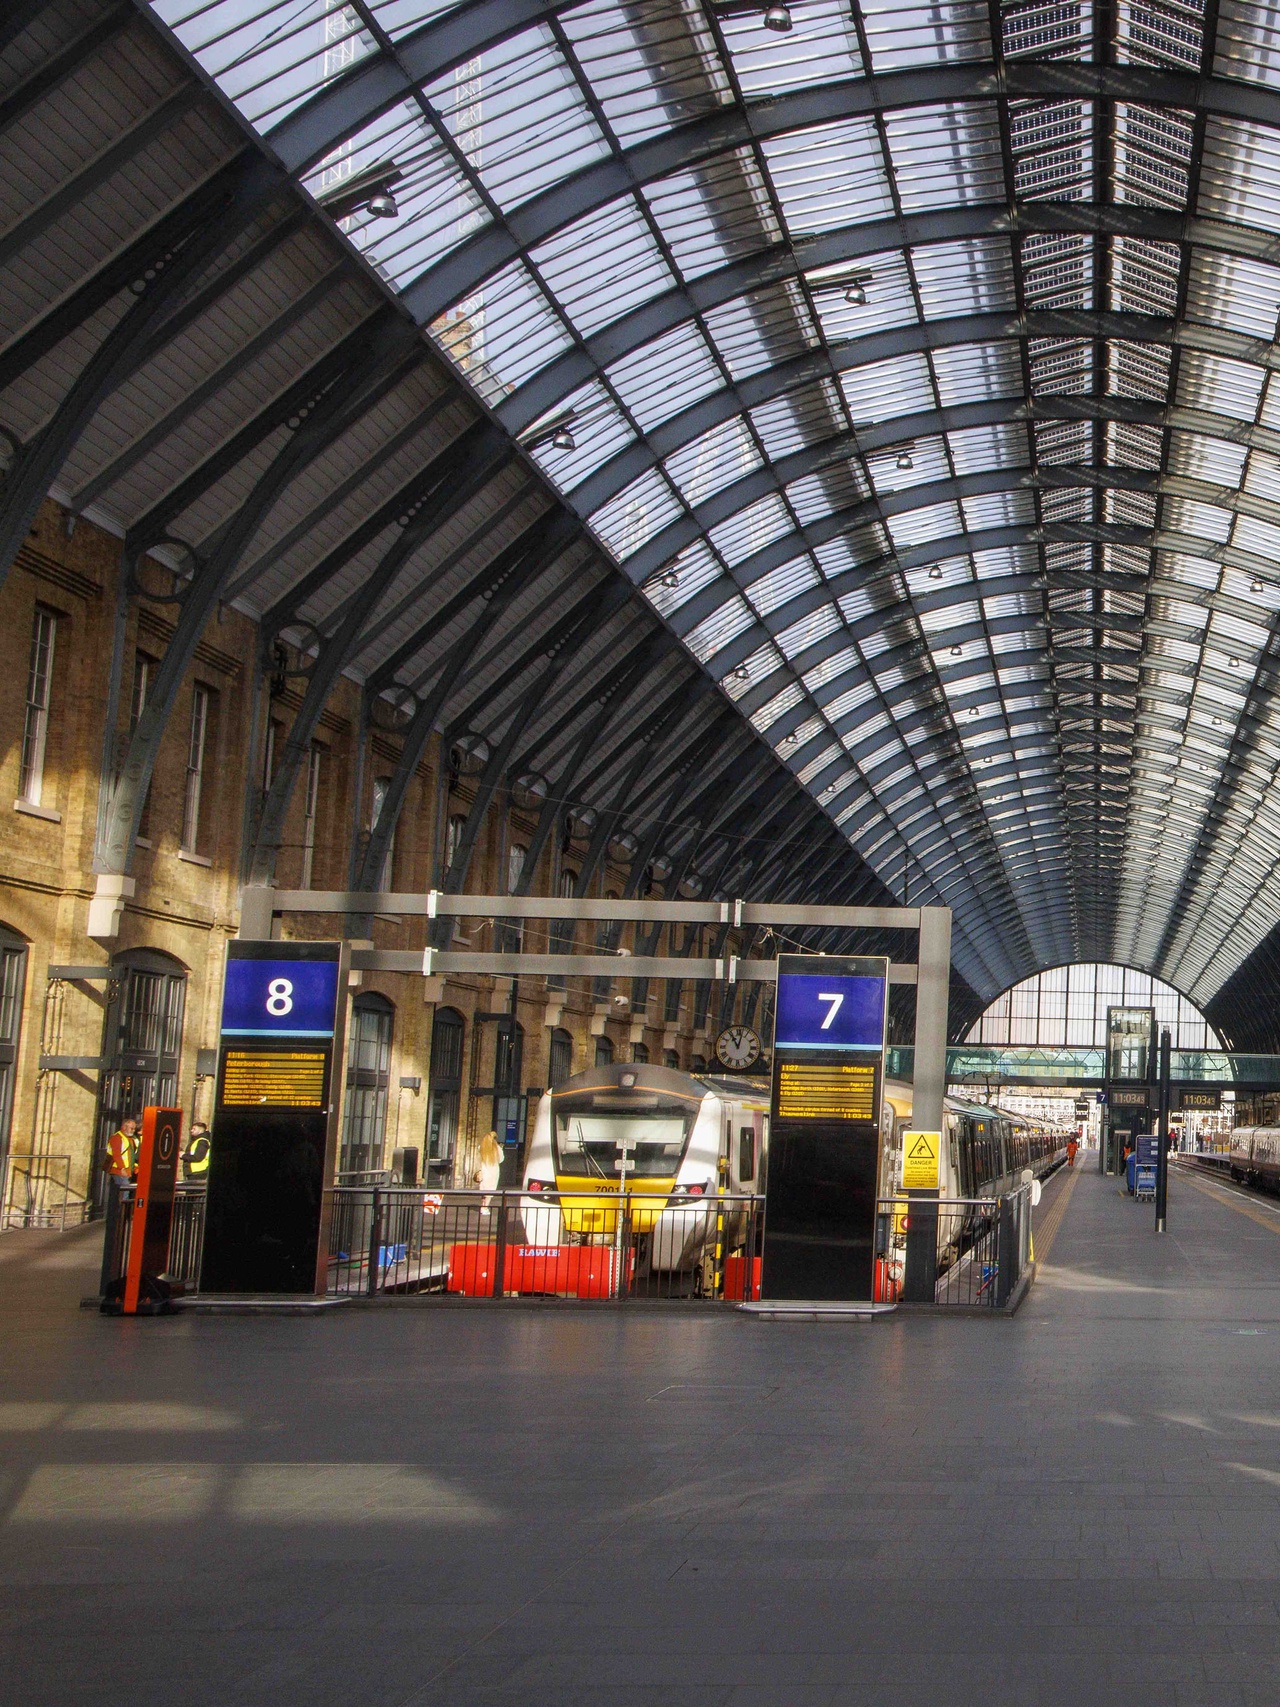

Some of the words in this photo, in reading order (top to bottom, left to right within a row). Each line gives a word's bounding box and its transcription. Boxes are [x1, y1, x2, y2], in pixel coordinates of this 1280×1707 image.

[266, 978, 293, 1016] 8
[818, 993, 844, 1029] 7
[519, 1249, 560, 1257] RAWIE
